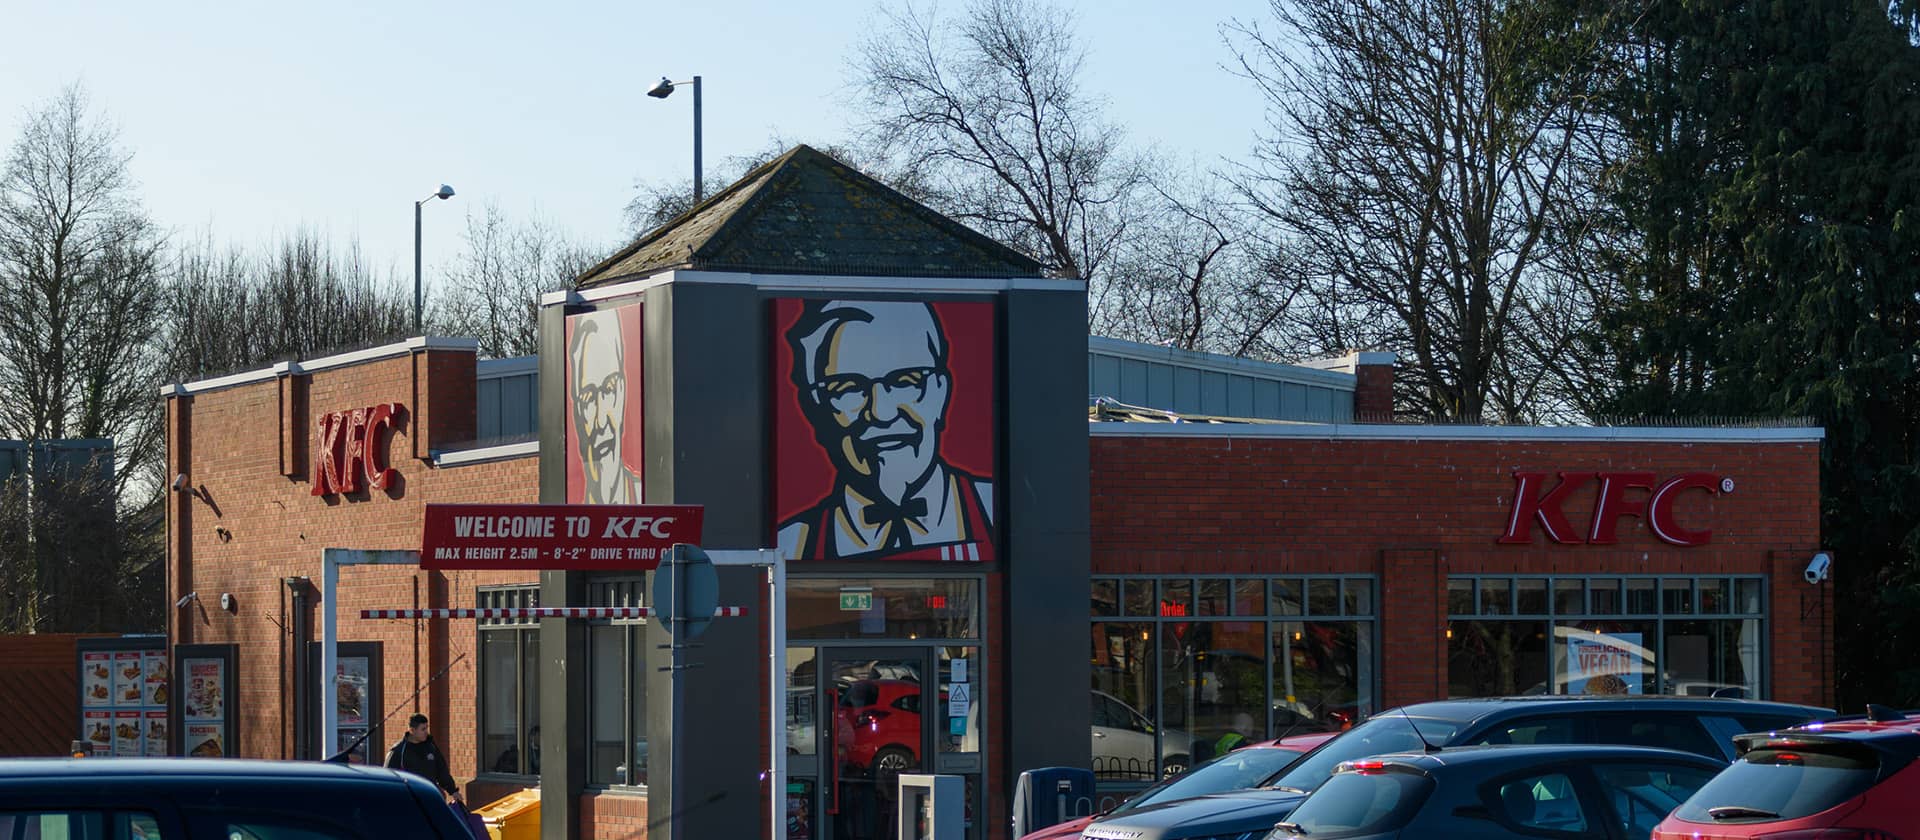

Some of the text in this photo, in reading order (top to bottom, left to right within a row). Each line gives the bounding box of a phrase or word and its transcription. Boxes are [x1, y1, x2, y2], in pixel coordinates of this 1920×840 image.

[311, 403, 401, 496] KFC
[454, 516, 674, 539] WELCOME TO KFC
[434, 547, 460, 560] MAX
[465, 547, 505, 560] HEIGHT
[509, 547, 538, 560] 2.5M
[590, 547, 622, 560] DRIVE
[628, 547, 656, 560] THRU
[1578, 653, 1631, 676] VEGAN
